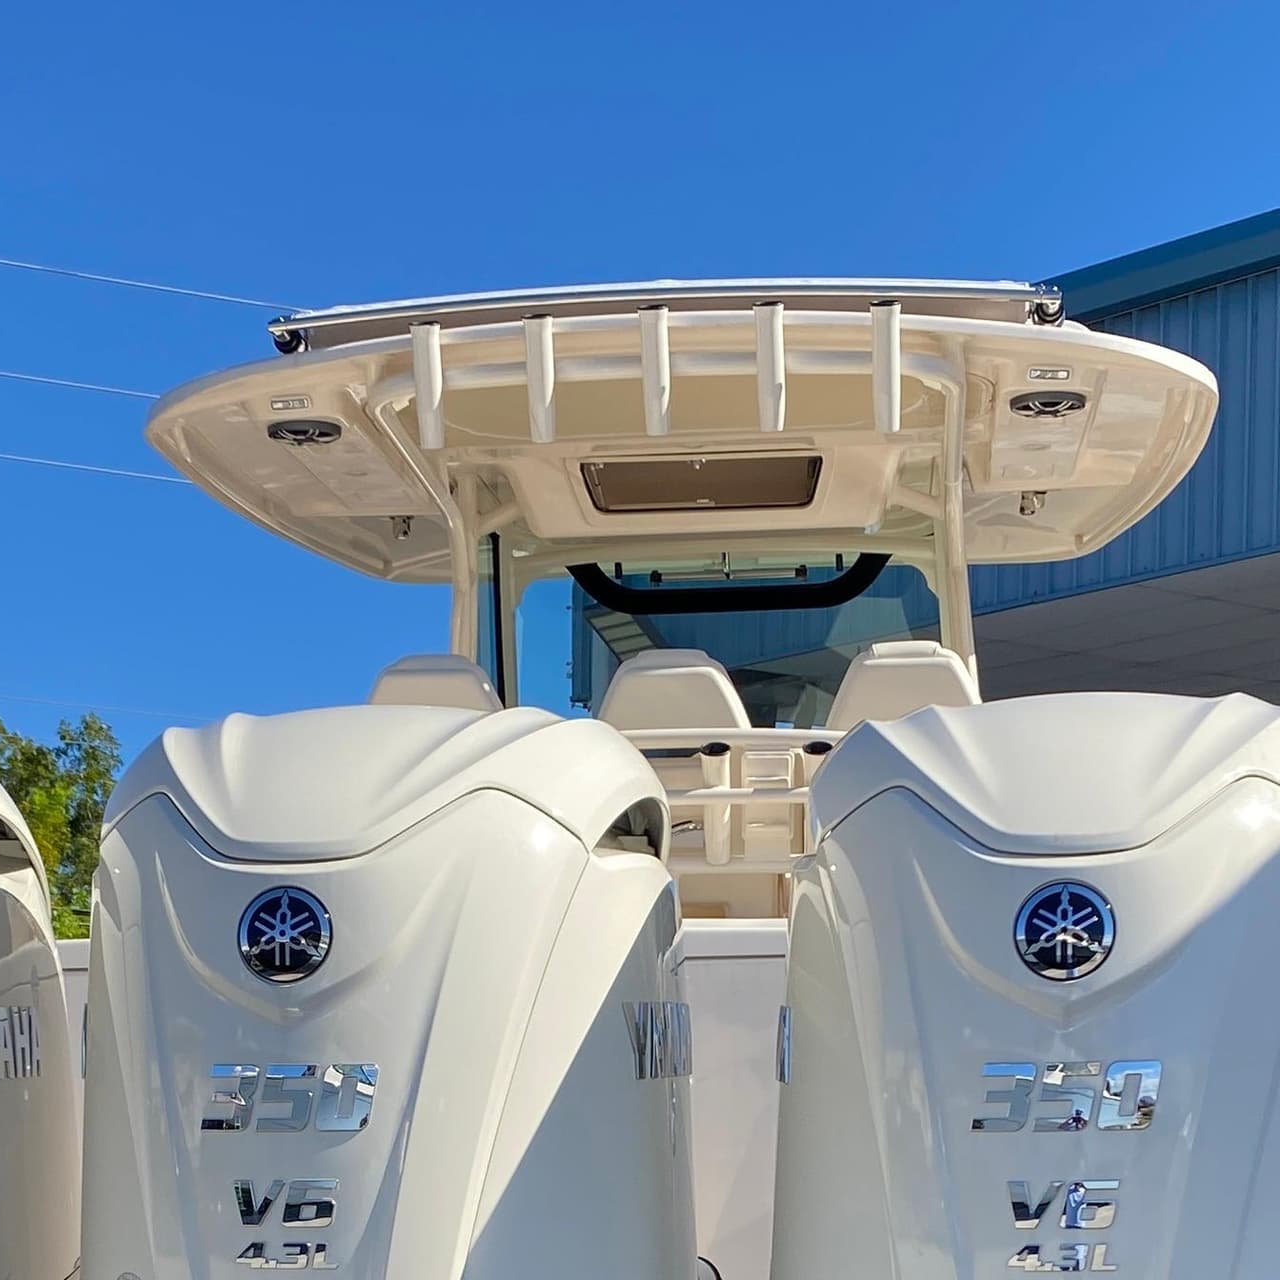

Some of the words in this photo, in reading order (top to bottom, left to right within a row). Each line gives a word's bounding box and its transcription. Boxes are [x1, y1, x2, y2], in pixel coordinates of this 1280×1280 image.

[200, 1063, 380, 1133] 350
[970, 1060, 1163, 1132] 350
[233, 1178, 339, 1228] V6
[1007, 1179, 1120, 1229] V6
[235, 1242, 339, 1270] 4.3L
[1007, 1242, 1118, 1272] 4.3L
